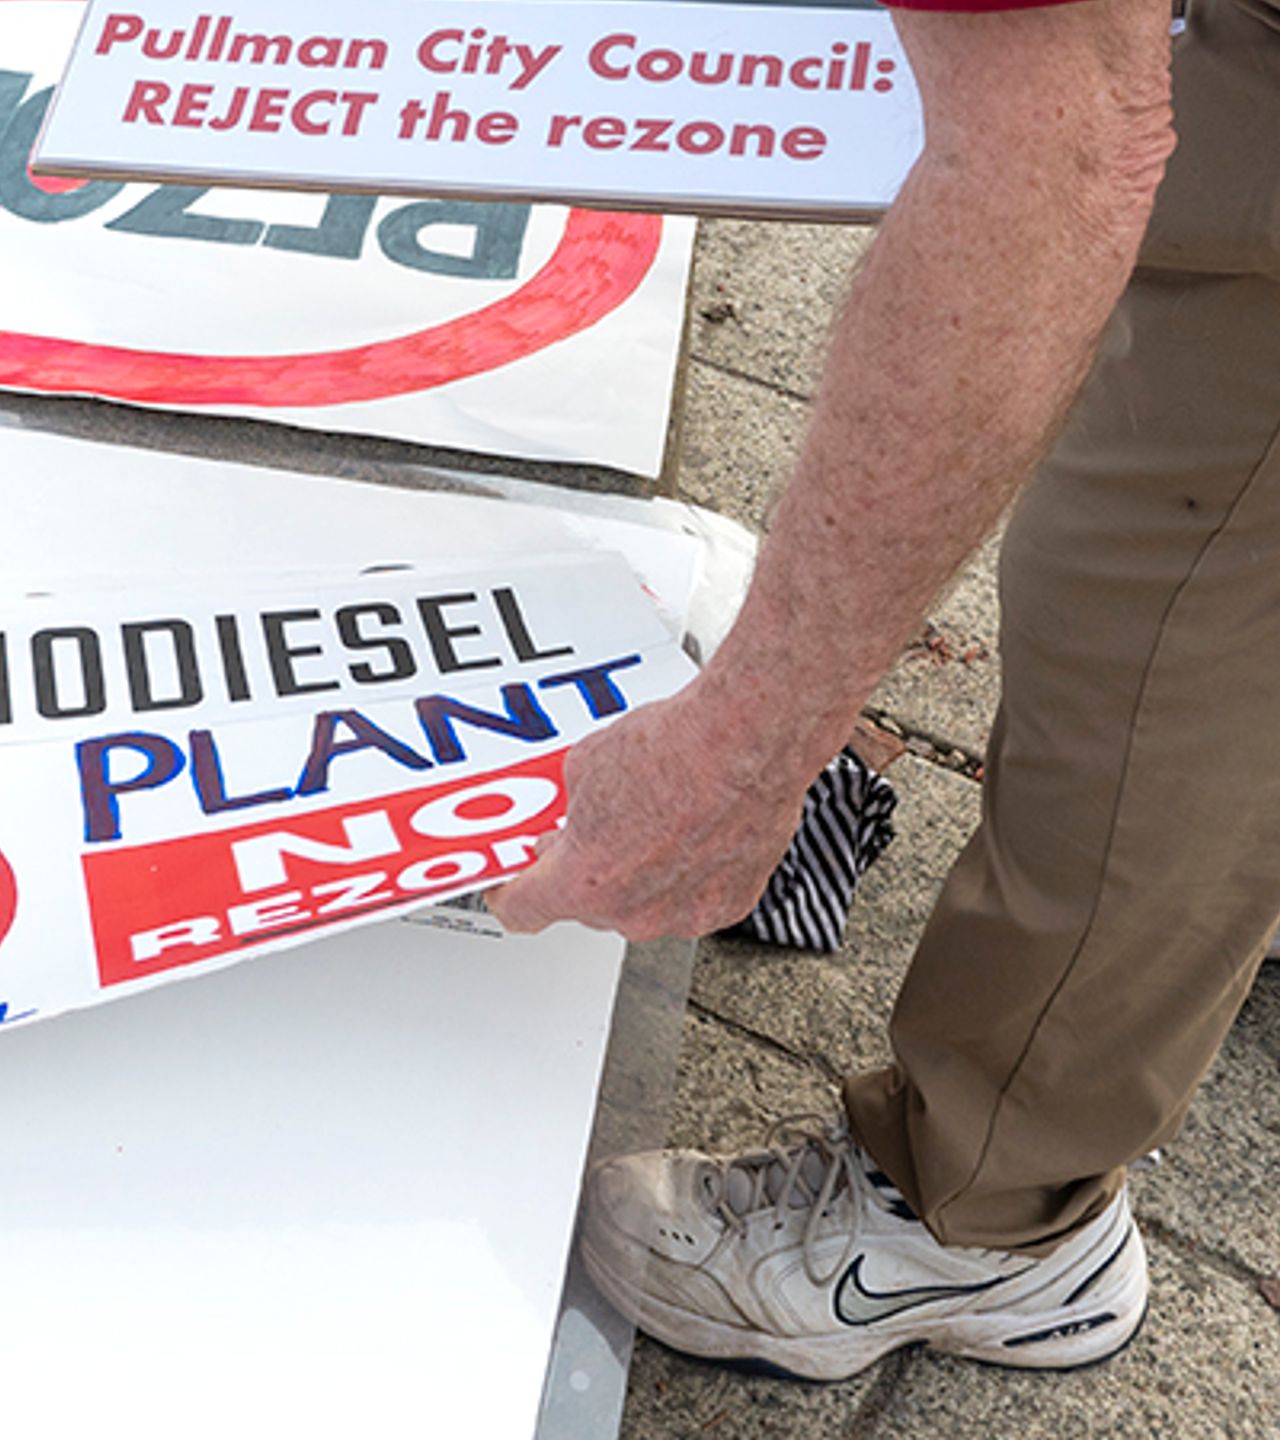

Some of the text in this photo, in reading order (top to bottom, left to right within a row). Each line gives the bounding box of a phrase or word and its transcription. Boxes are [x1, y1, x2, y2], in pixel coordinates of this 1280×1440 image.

[94, 13, 897, 93] Pullman City Council:
[122, 80, 829, 160] REJECT the rezone
[74, 655, 643, 844] PLANT
[129, 815, 568, 961] REZO
[230, 776, 560, 894] NO
